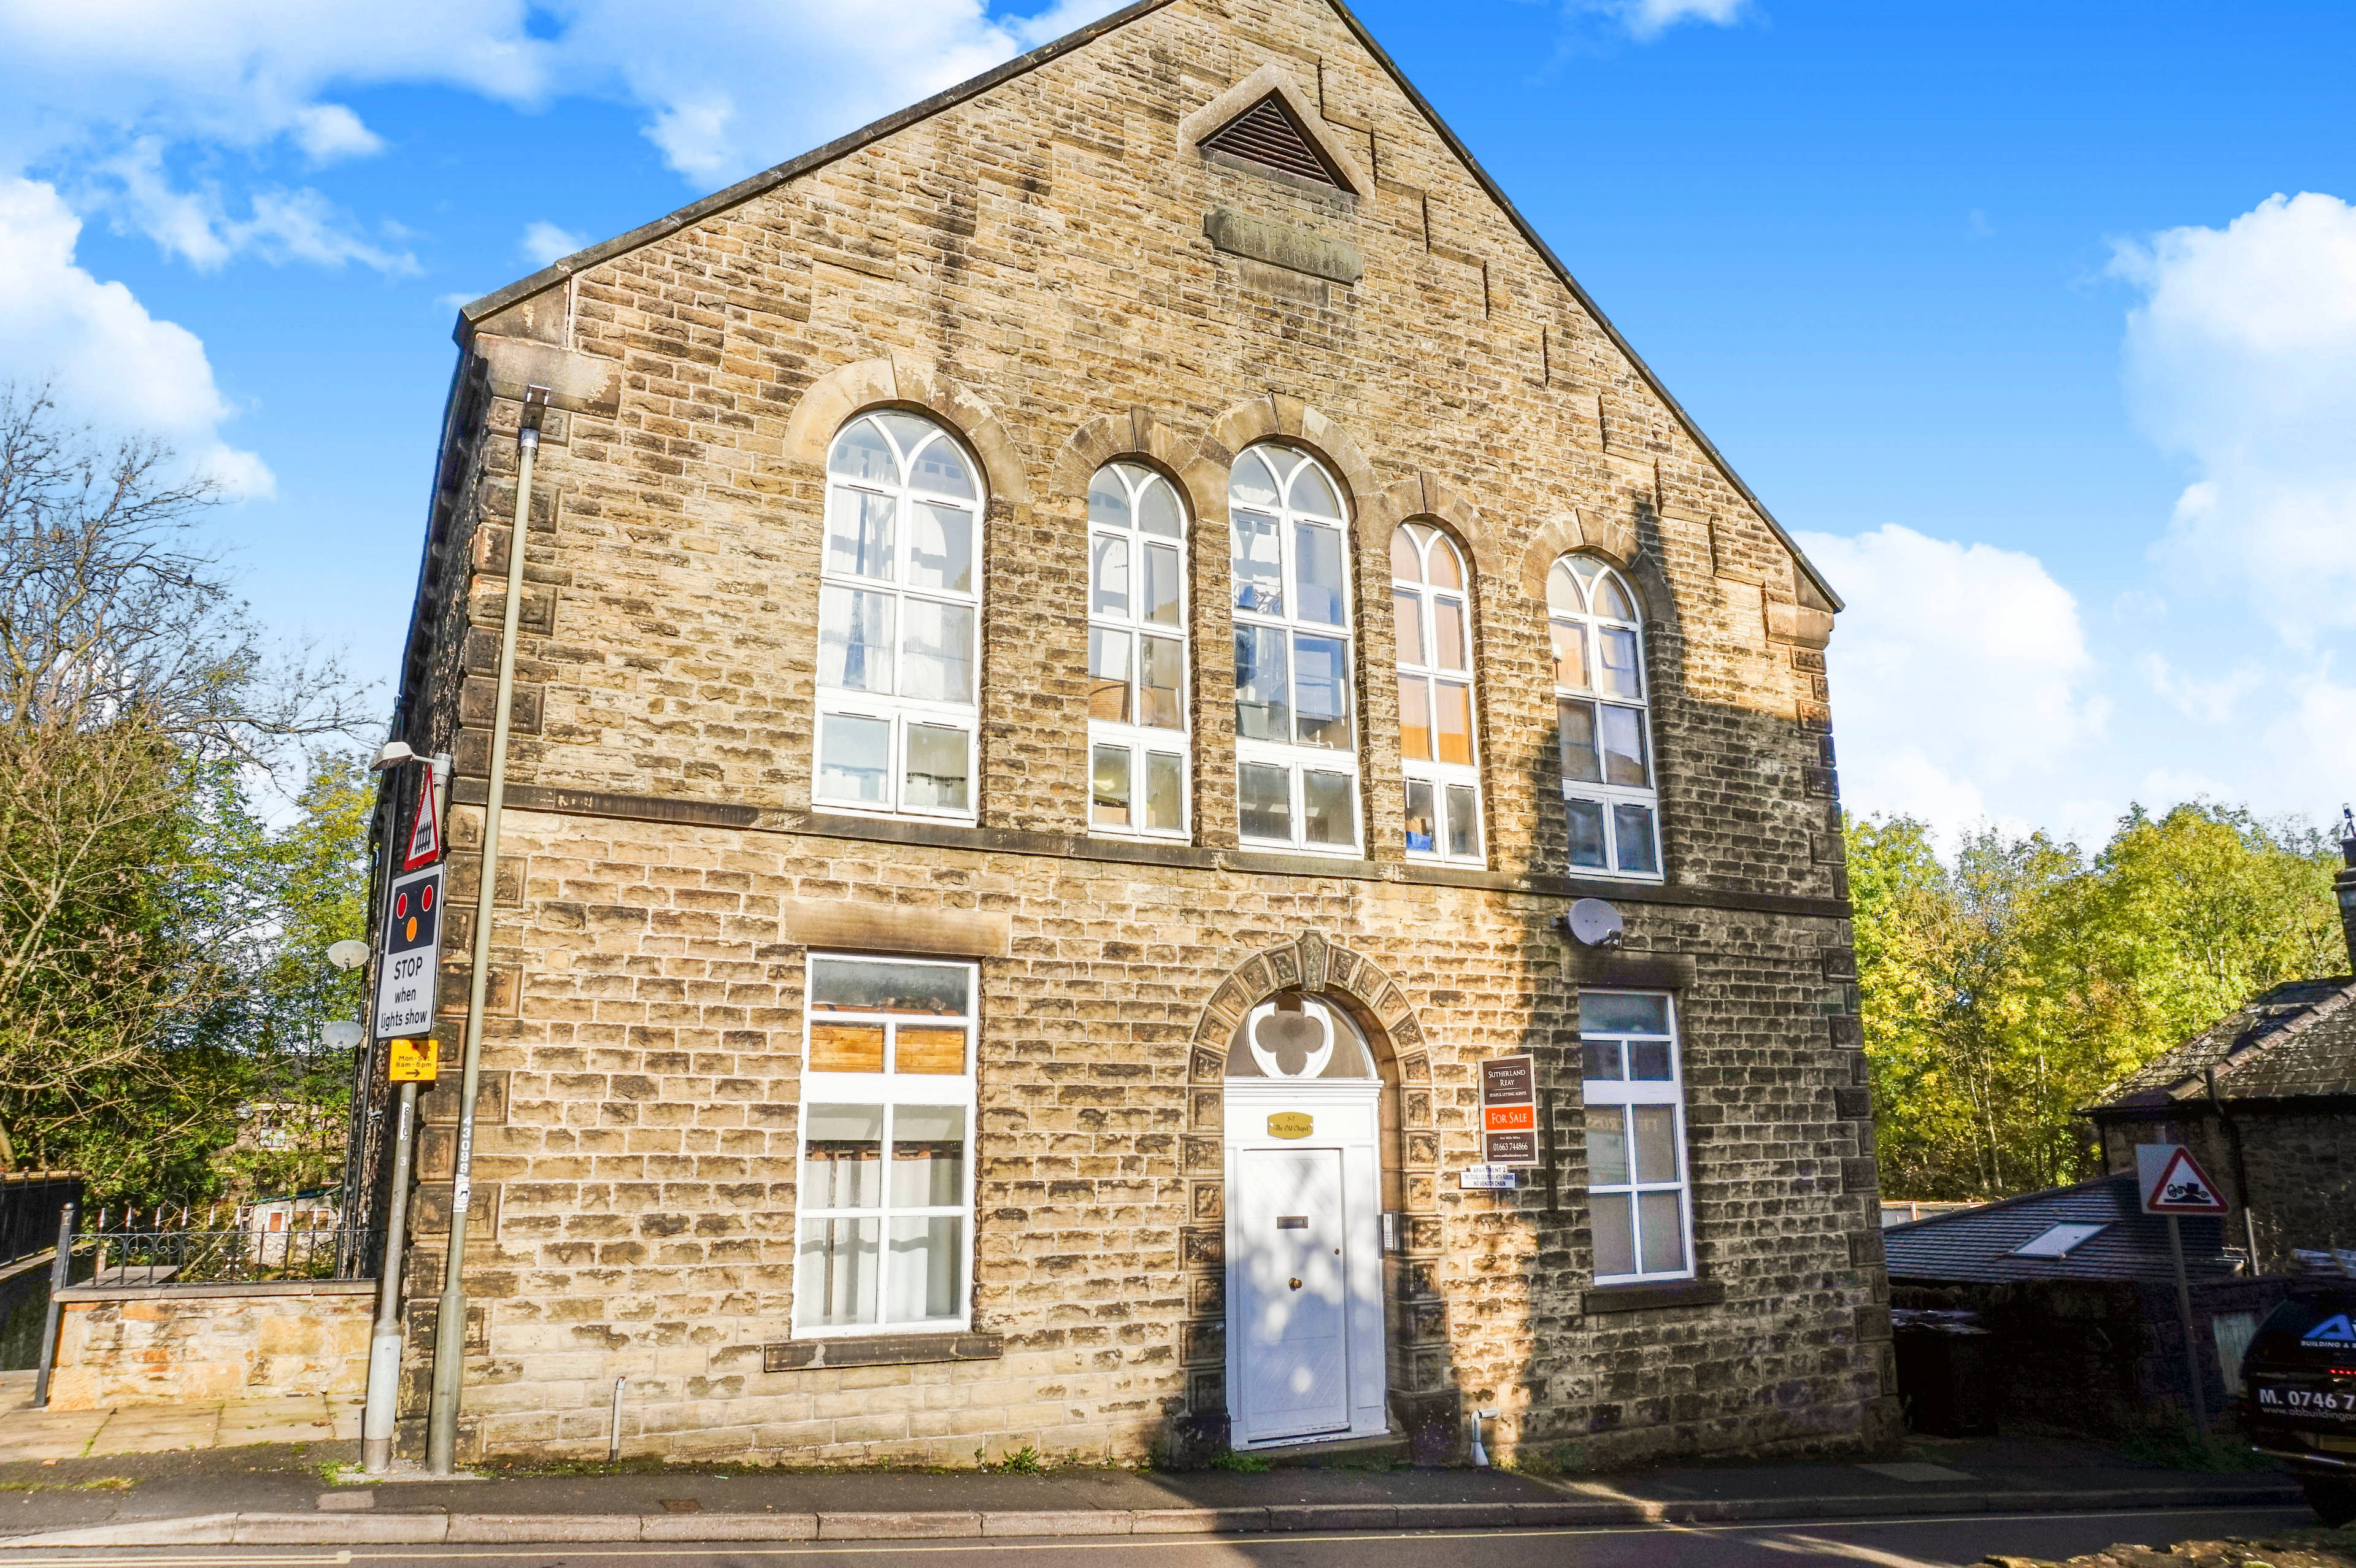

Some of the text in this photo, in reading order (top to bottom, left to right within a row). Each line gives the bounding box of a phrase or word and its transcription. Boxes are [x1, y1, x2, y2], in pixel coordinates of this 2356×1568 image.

[1228, 214, 1331, 253] METHODIST
[1220, 230, 1344, 275] FREE CHURCH
[1268, 272, 1306, 298] 1884
[394, 956, 423, 980] STOP
[395, 986, 416, 1004] when
[380, 1008, 428, 1031] lights show
[1488, 1069, 1526, 1078] SUTHERLAND
[1492, 1112, 1527, 1124] FOR SALE
[1509, 1142, 1528, 1150] 744866
[2303, 1313, 2356, 1341] A
[2258, 1388, 2355, 1410] M. 0746 7
